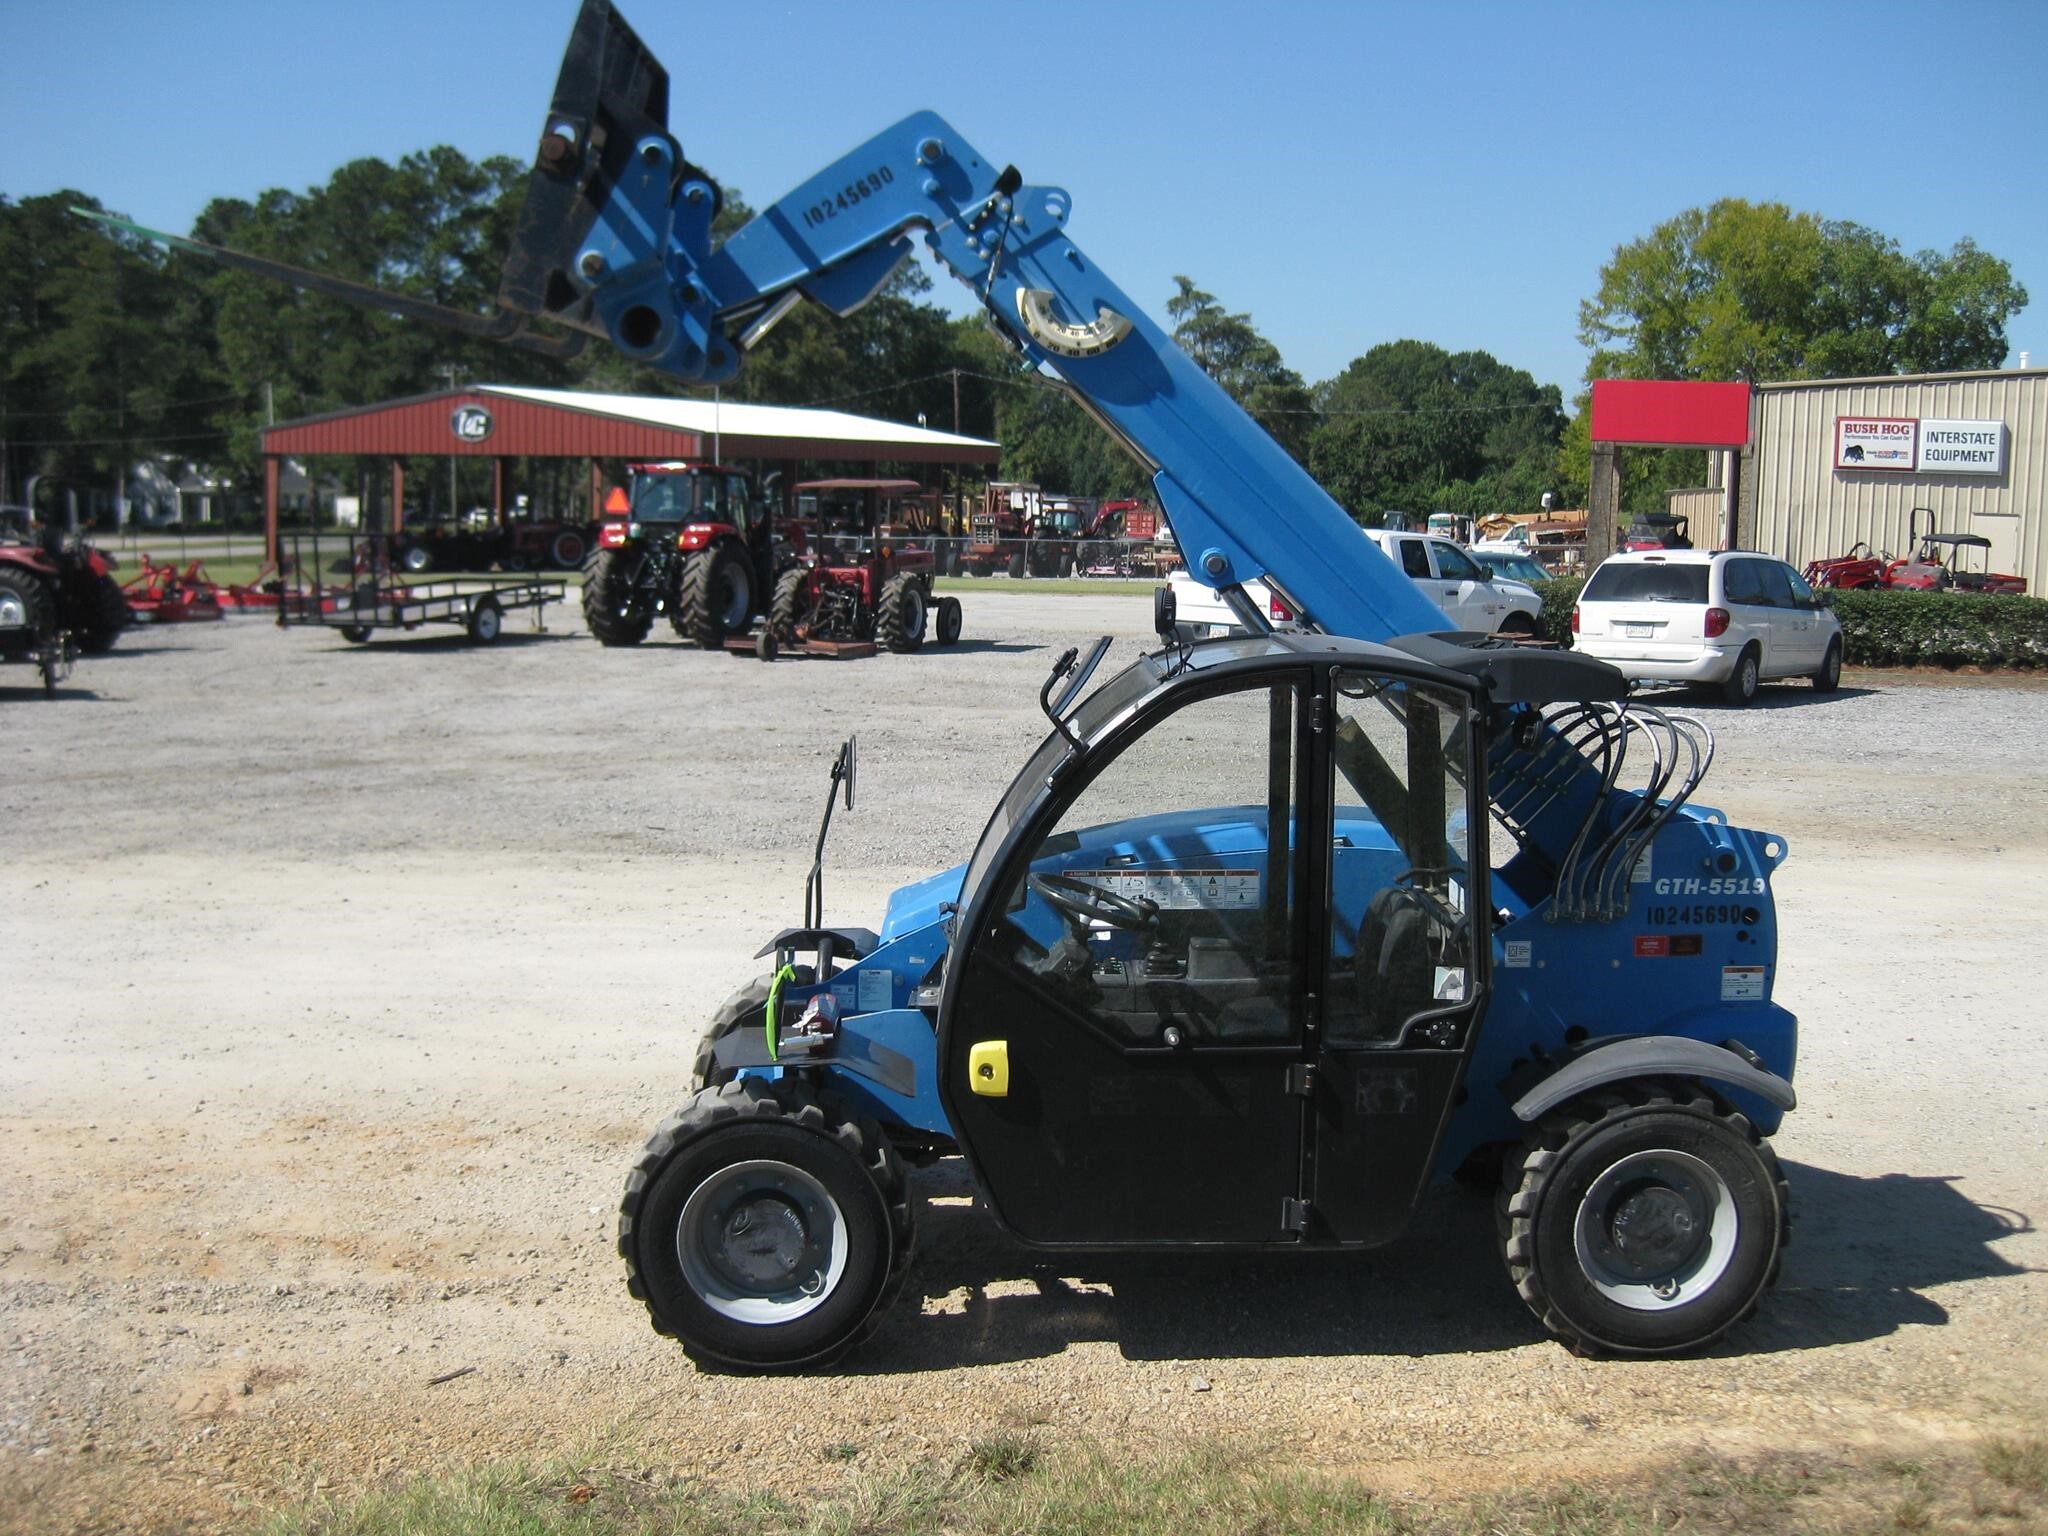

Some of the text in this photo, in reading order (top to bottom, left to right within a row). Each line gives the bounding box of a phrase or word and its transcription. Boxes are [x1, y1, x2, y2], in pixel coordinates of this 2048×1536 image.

[803, 165, 894, 229] 10245690
[1844, 423, 1910, 435] BUSH HOG
[1926, 431, 1995, 445] INTERSTATE
[1925, 449, 1995, 463] EQUIPMENT
[1655, 877, 1765, 895] GTH-5519
[1647, 904, 1740, 926] 10245690
